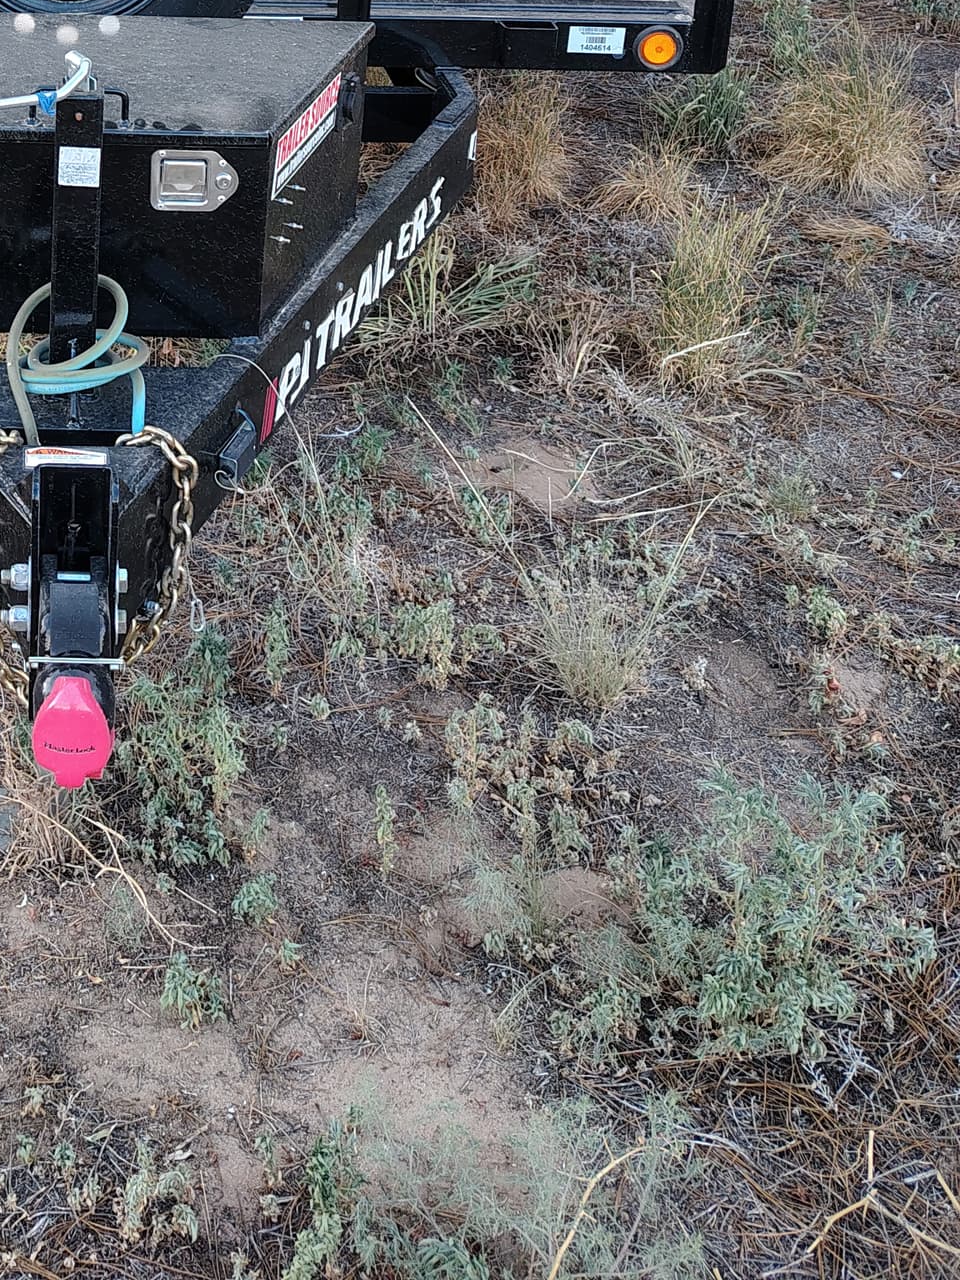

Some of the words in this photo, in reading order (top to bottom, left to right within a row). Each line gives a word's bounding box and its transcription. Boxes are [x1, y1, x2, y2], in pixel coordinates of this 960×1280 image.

[580, 43, 611, 52] 1404614
[277, 109, 311, 169] TRAILER
[310, 74, 341, 130] SOURCE
[274, 336, 312, 422] PJ
[316, 175, 446, 370] TRAILERS
